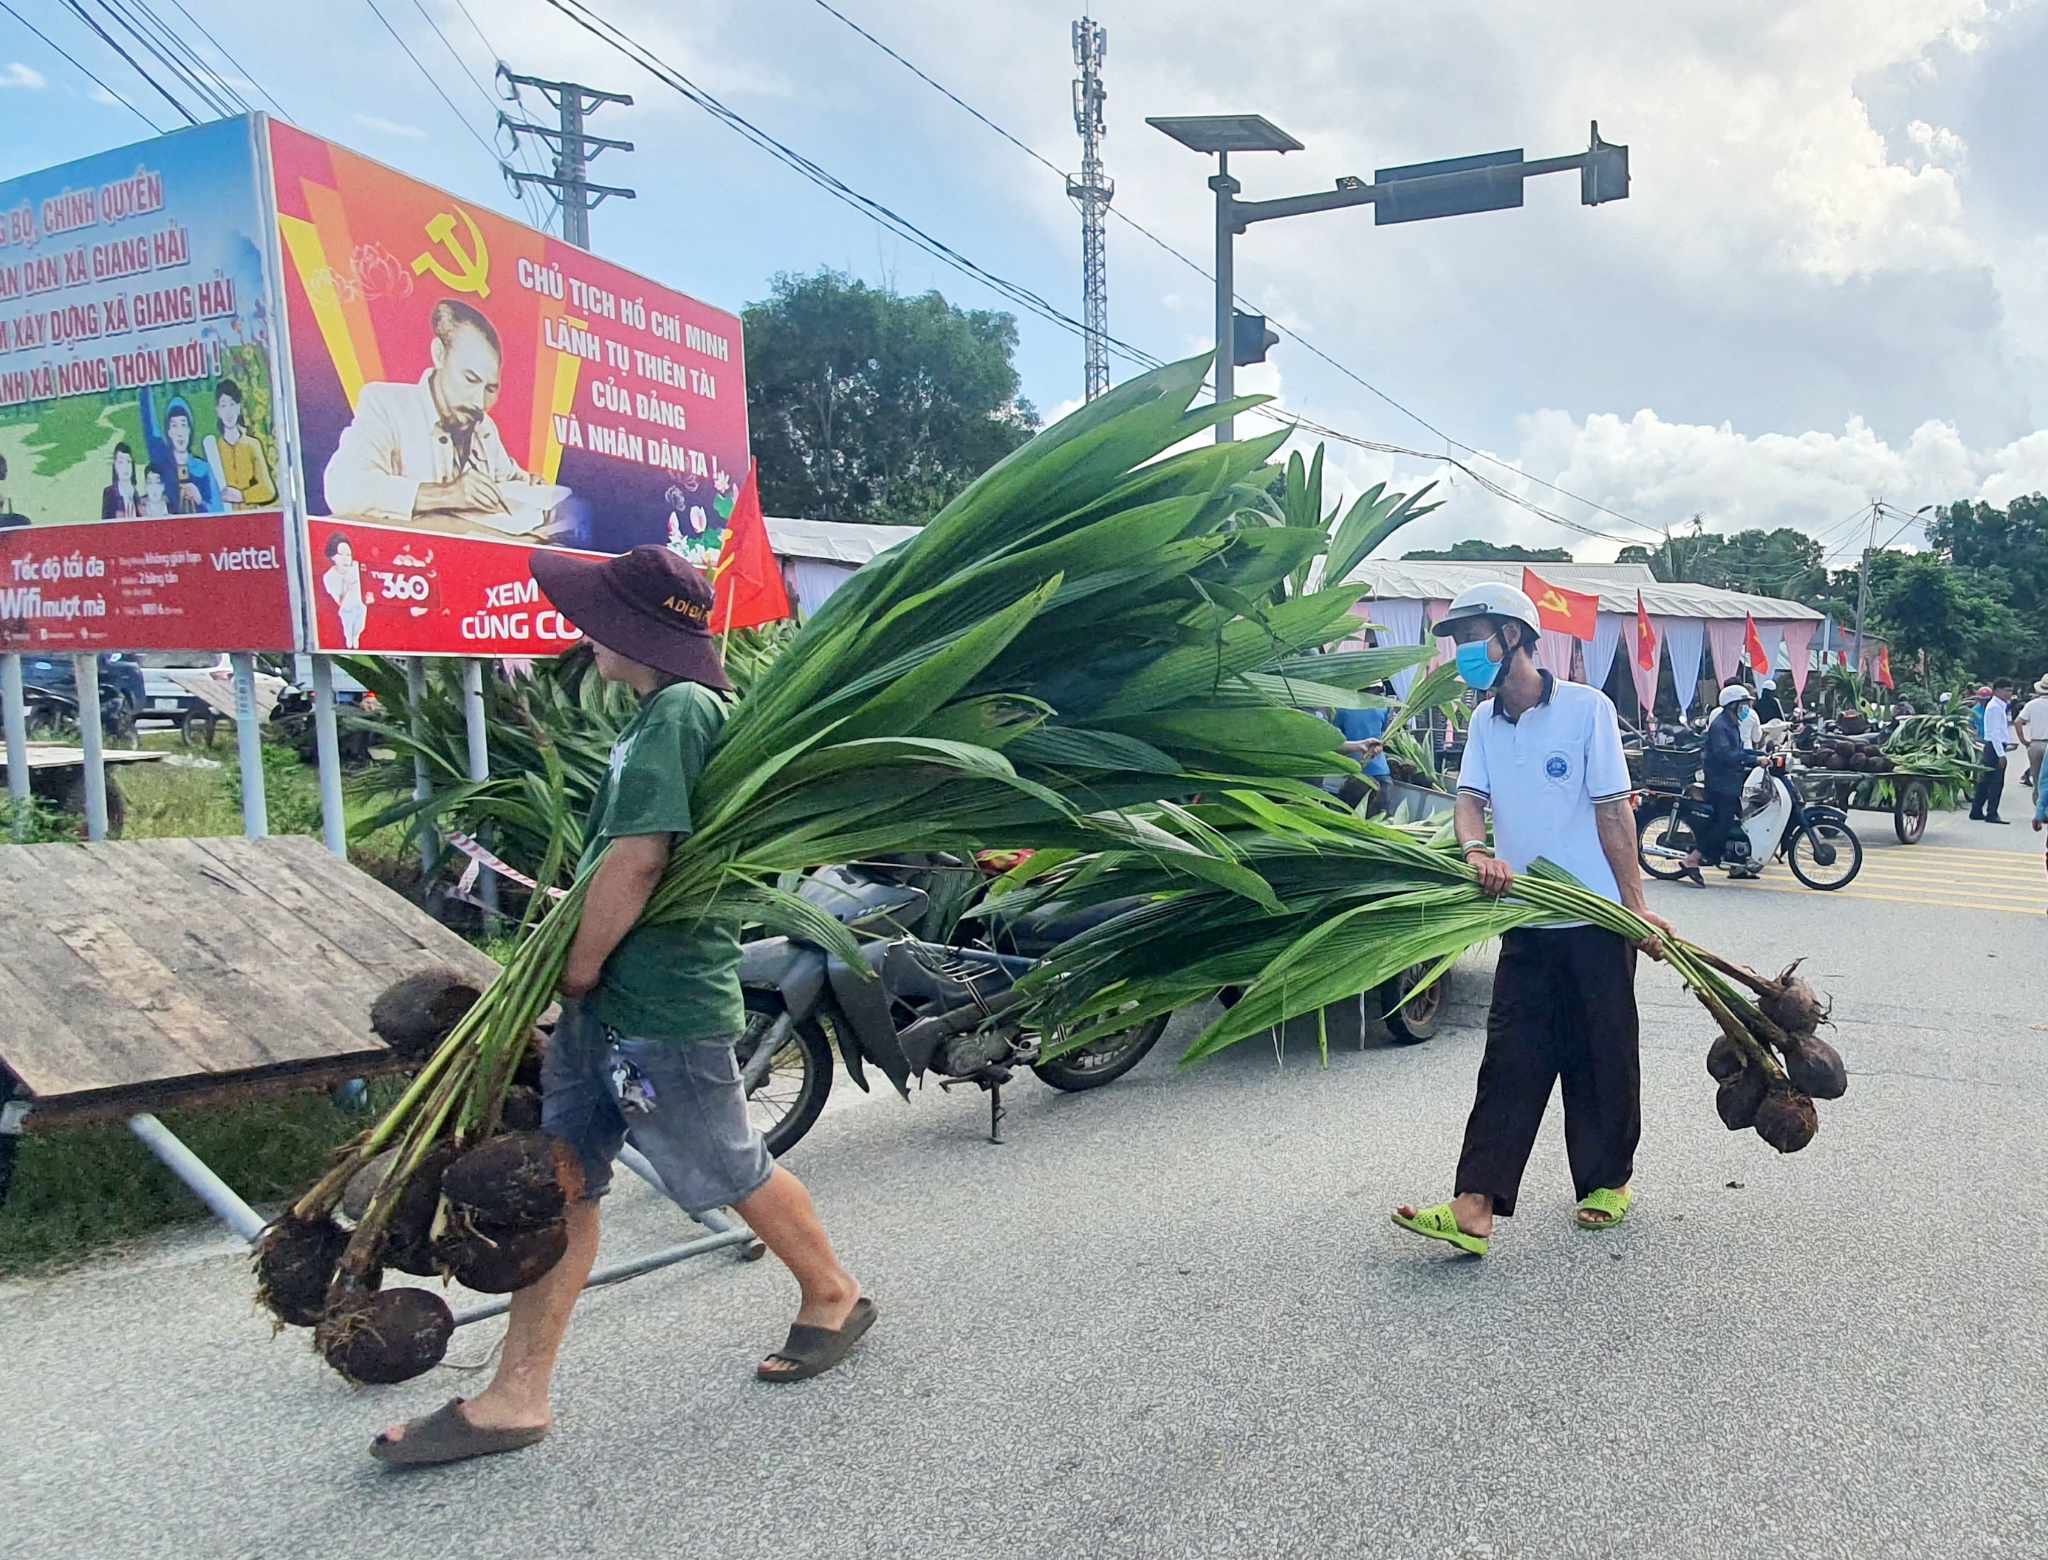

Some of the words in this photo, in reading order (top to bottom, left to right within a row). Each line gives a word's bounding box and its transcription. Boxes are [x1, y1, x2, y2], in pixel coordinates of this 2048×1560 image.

[44, 187, 97, 234] CHÍNH
[102, 166, 162, 223] QUYỀN
[93, 236, 149, 278] GIANG
[51, 303, 98, 346] DỰNG
[104, 294, 129, 333] XÃ
[133, 286, 193, 327] GIANG
[518, 258, 564, 300] CHỦ
[569, 277, 615, 320] TỊCH
[621, 297, 646, 331] HỒ
[651, 311, 681, 344] CHÍ
[685, 323, 728, 362] MINH
[30, 361, 53, 399] XÃ
[57, 355, 108, 396] NÔNG
[112, 346, 162, 387] THÔN
[167, 337, 207, 379] MỚI
[545, 317, 600, 362] LÃNH
[605, 340, 630, 376] TỤ
[634, 350, 687, 390] THIÊN
[690, 367, 716, 400] TÀI
[592, 377, 632, 416] CỦA
[636, 390, 686, 431] ĐẢNG
[554, 415, 583, 449] VÀ
[588, 423, 643, 463] NHÂN
[648, 437, 684, 472] DÂN
[688, 449, 709, 478] TA
[11, 552, 39, 581] Tốc
[42, 555, 60, 583] độ
[63, 550, 83, 578] tối
[86, 556, 104, 577] đa
[210, 546, 280, 572] viettel
[43, 595, 80, 620] mượt
[83, 593, 105, 616] mà
[485, 577, 539, 608] XEM
[462, 610, 529, 640] CŨNG
